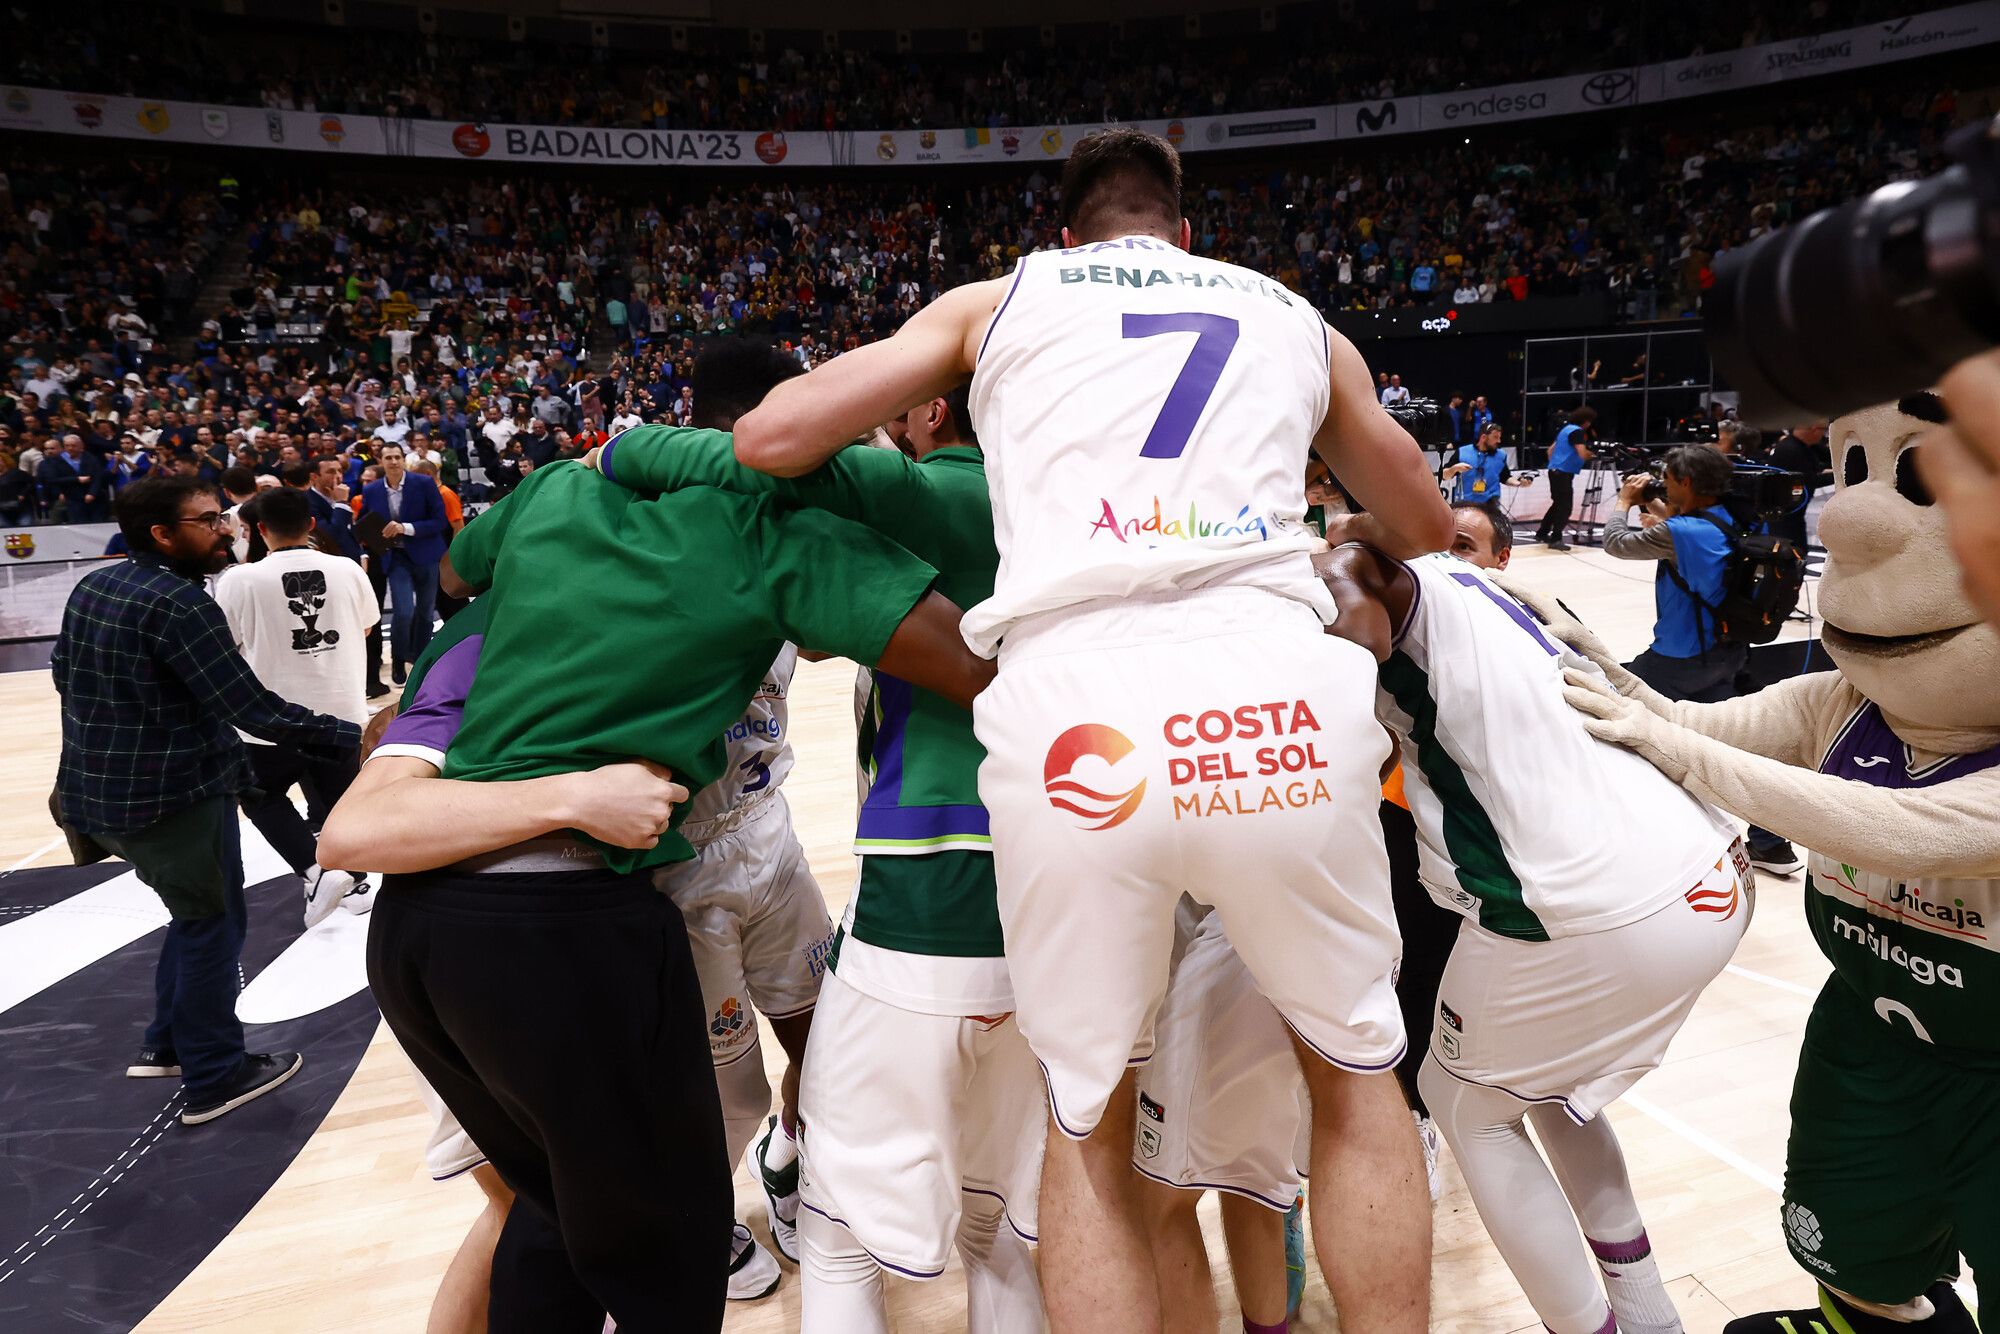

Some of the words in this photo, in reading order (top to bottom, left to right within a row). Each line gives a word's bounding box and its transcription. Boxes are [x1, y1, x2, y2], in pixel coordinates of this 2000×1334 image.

[1767, 40, 1852, 70] SPALDING
[1443, 92, 1546, 120] endesa
[506, 127, 742, 160] BADALONA'23
[1121, 312, 1240, 459] 7
[1163, 699, 1322, 748] COSTA
[739, 750, 771, 794] 3
[1168, 752, 1249, 786] DEL
[1255, 743, 1328, 776] SOL
[1173, 778, 1332, 820] MÁLAGA
[1889, 883, 1985, 929] Unicaja
[1141, 1102, 1158, 1119] acb
